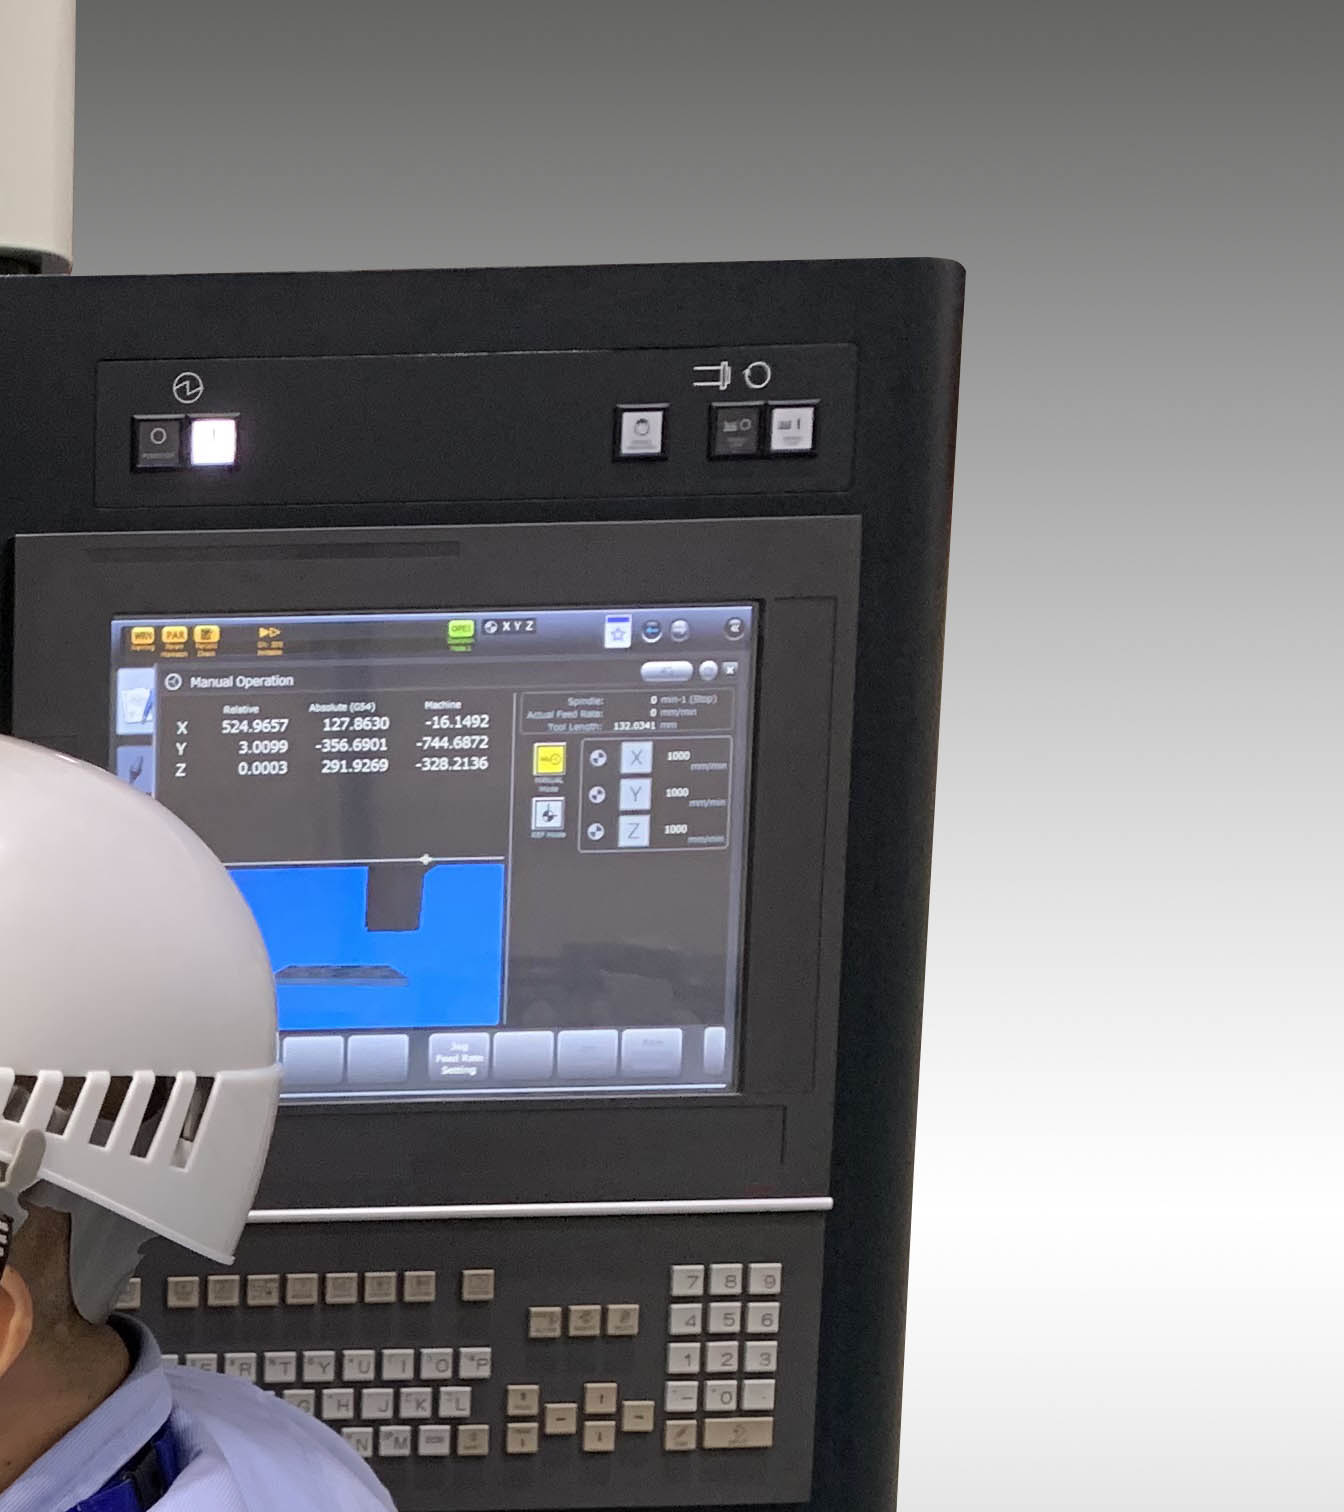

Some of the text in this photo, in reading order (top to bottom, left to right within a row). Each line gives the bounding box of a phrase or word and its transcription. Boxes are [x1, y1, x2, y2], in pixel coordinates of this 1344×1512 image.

[502, 620, 534, 631] X Y Z
[190, 675, 294, 689] Manual Operation
[223, 705, 260, 714] Relative
[309, 703, 347, 713] Absolute
[425, 701, 462, 710] Machine
[176, 715, 490, 735] X 524.9657 127.8630 -16.1492
[176, 736, 489, 755] Y 3.0099 -356.6901 -744.6872
[631, 749, 691, 766] X 1000
[175, 757, 489, 777] Z 0.0003 291.9269 -328.2136
[630, 786, 689, 802] Y 1000
[628, 822, 688, 839] Z 1000
[687, 1274, 776, 1289] 7 8 9
[685, 1312, 774, 1328] 4 5 6
[239, 1362, 251, 1376] R
[279, 1361, 292, 1375] T
[318, 1361, 331, 1374] Y
[358, 1360, 370, 1374] U
[435, 1358, 449, 1372] O
[476, 1358, 490, 1371] P
[684, 1352, 771, 1367] 1 2 3
[337, 1399, 350, 1412] H
[378, 1399, 389, 1413] J
[415, 1399, 427, 1412] K
[455, 1398, 466, 1411] L
[720, 1391, 733, 1405] 0
[356, 1436, 408, 1451] N M
